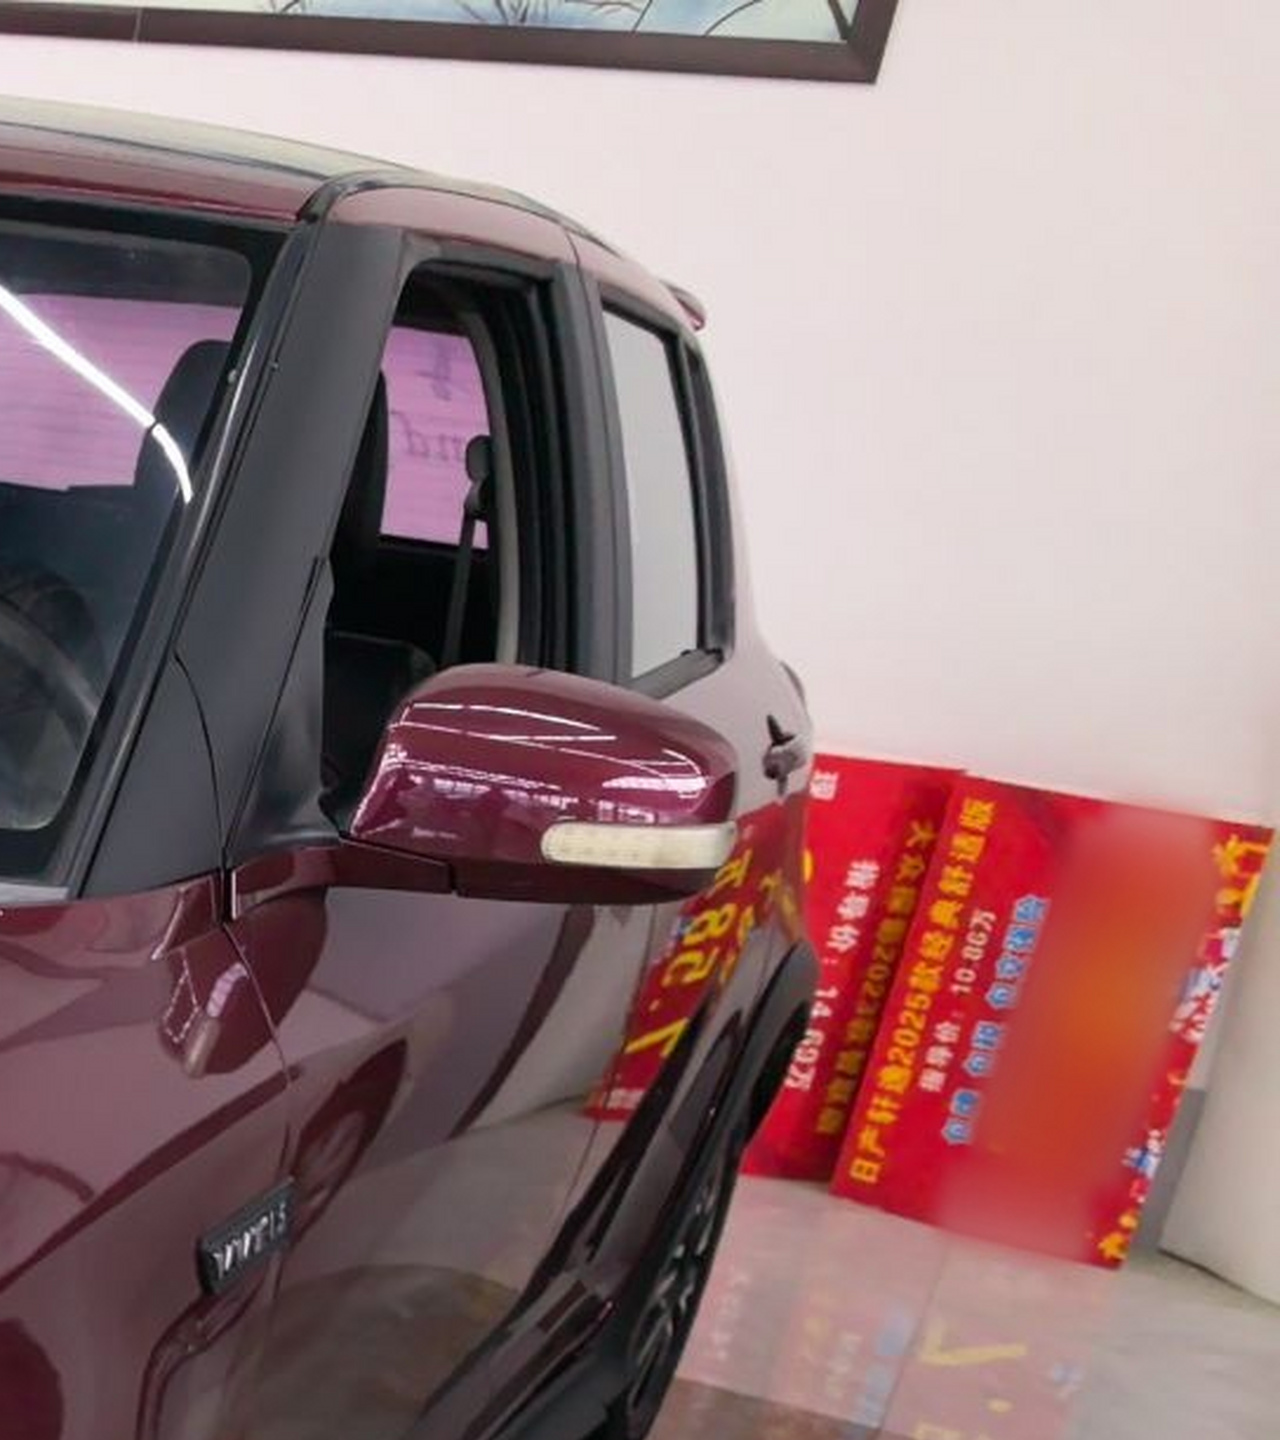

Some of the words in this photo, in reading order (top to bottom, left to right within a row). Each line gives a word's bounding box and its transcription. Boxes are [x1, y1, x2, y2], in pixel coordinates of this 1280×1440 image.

[849, 796, 997, 1186] 日产轩逸2025款经典舒适版
